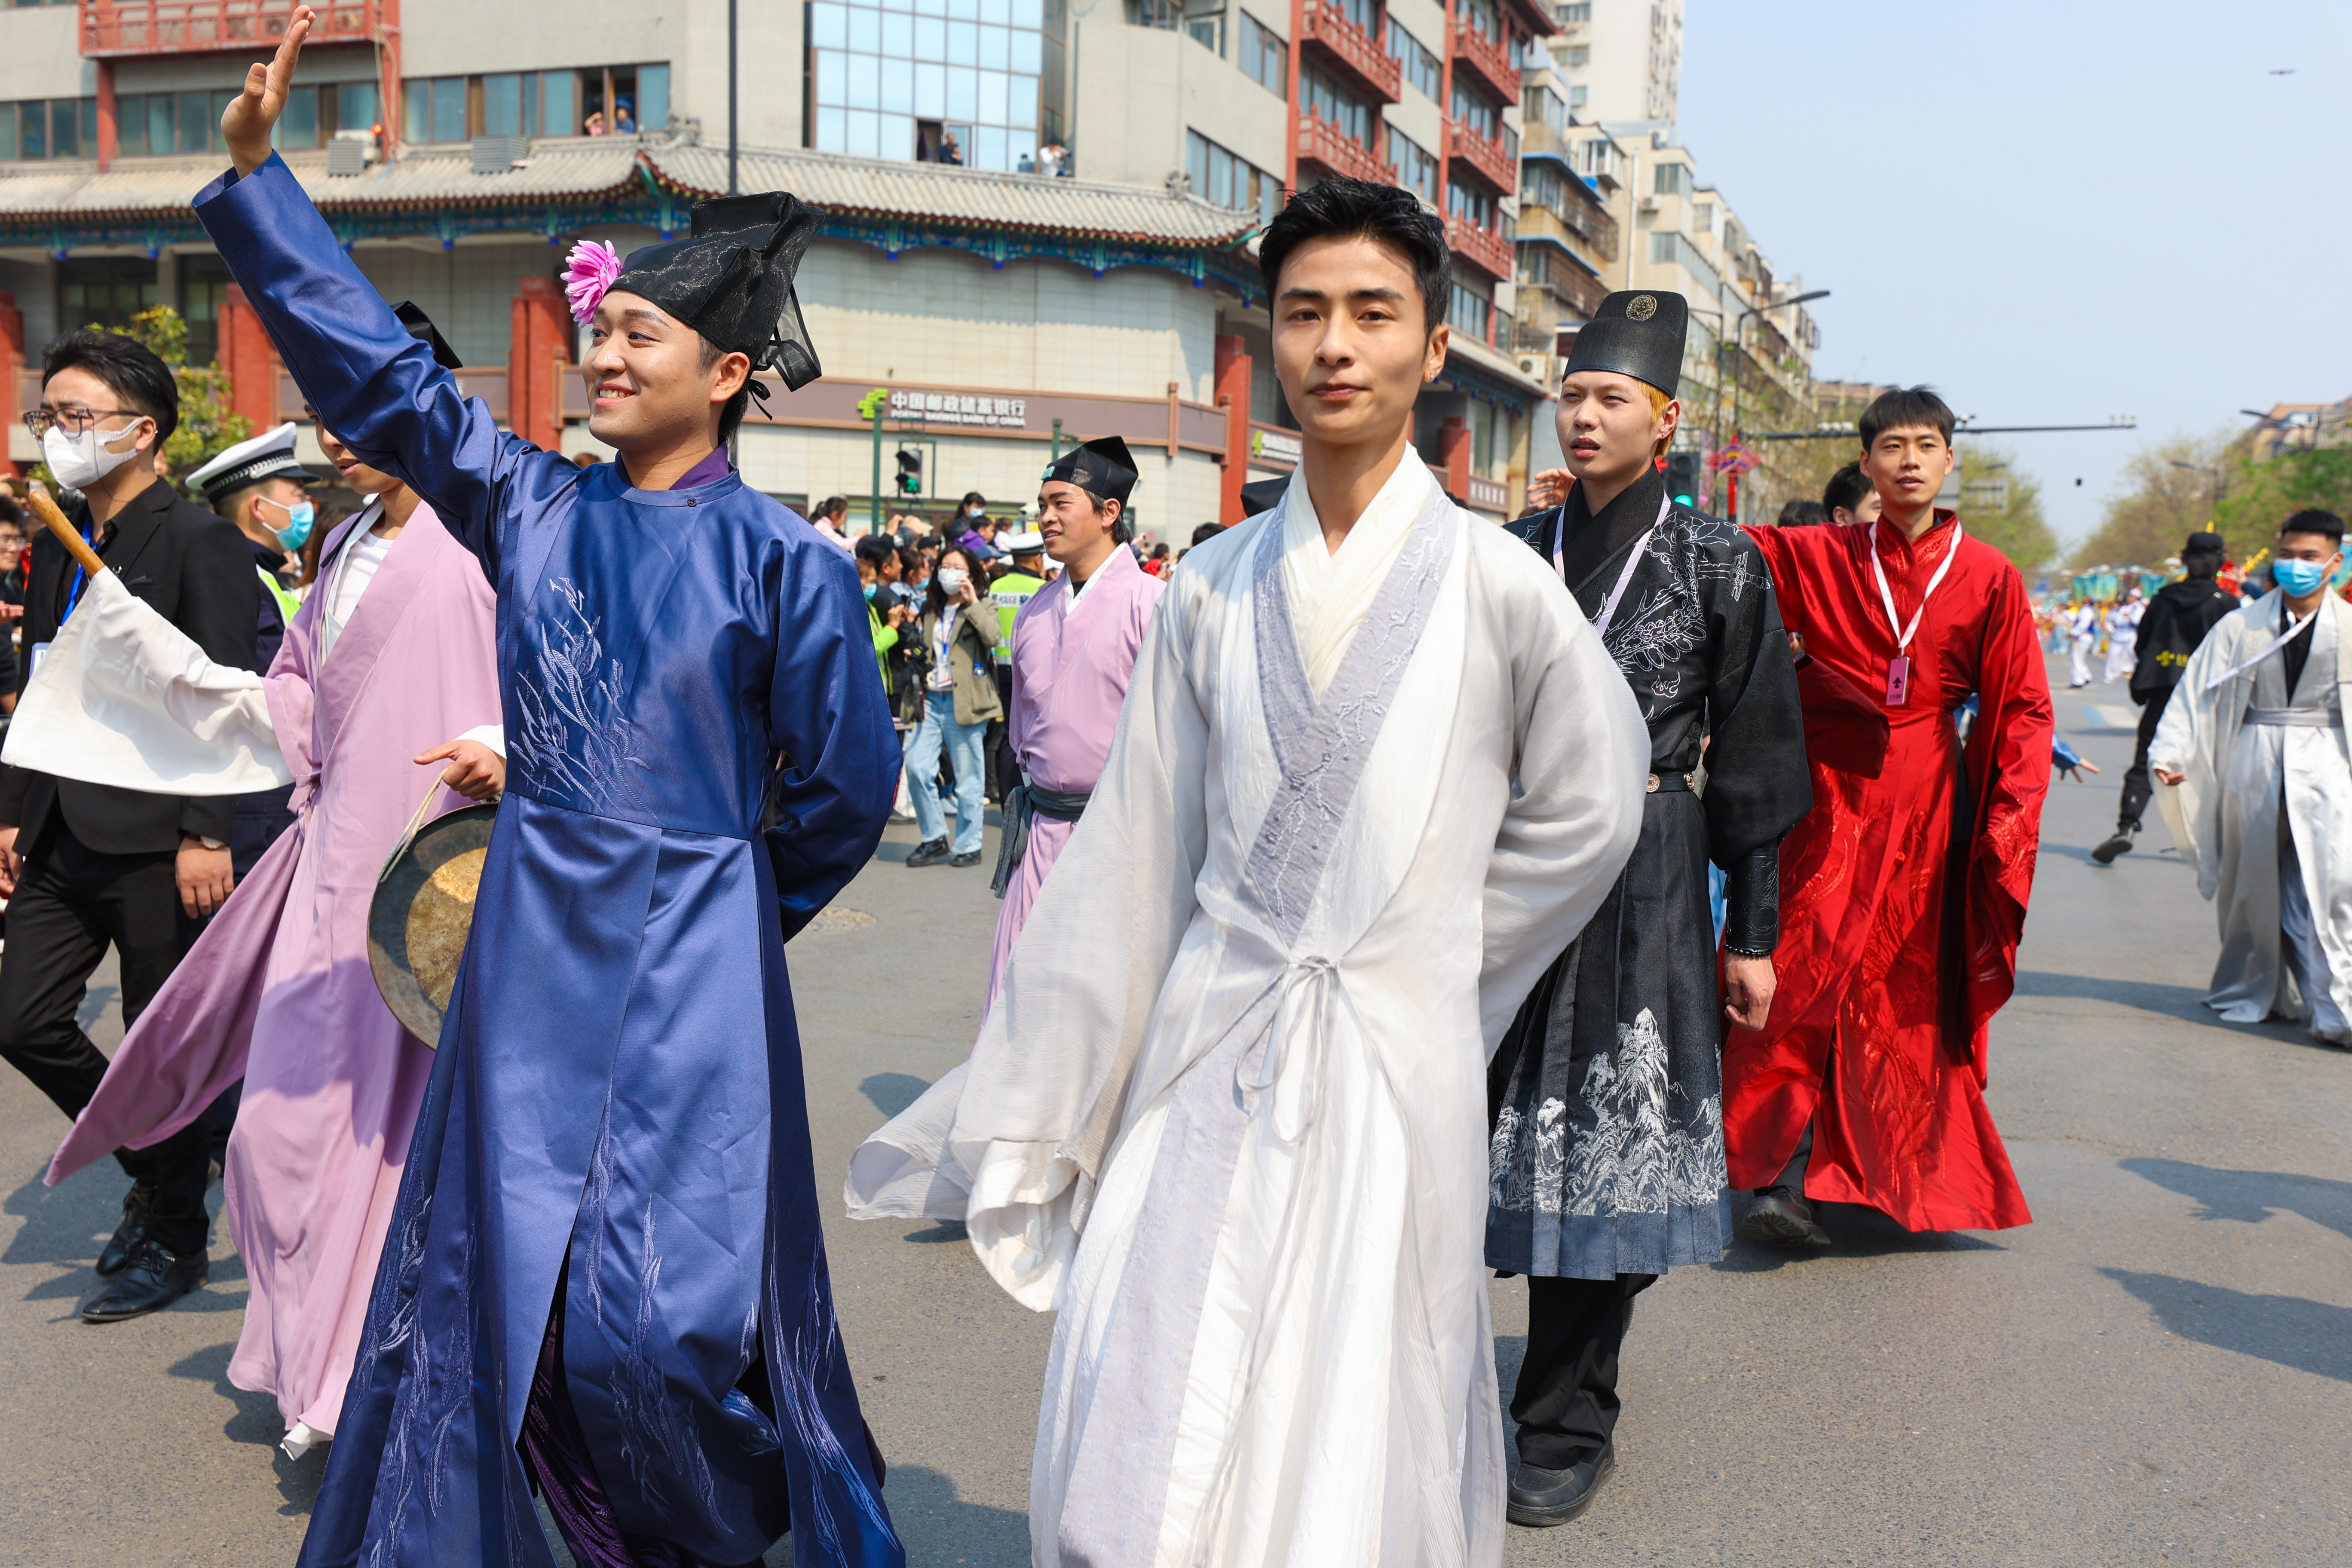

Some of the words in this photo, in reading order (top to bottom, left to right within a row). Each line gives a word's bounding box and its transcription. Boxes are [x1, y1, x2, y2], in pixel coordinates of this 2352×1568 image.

[891, 391, 1026, 416] 中国邮政储蓄银行
[962, 414, 985, 424] BANK
[986, 415, 998, 425] OF
[999, 416, 1026, 426] CHINA
